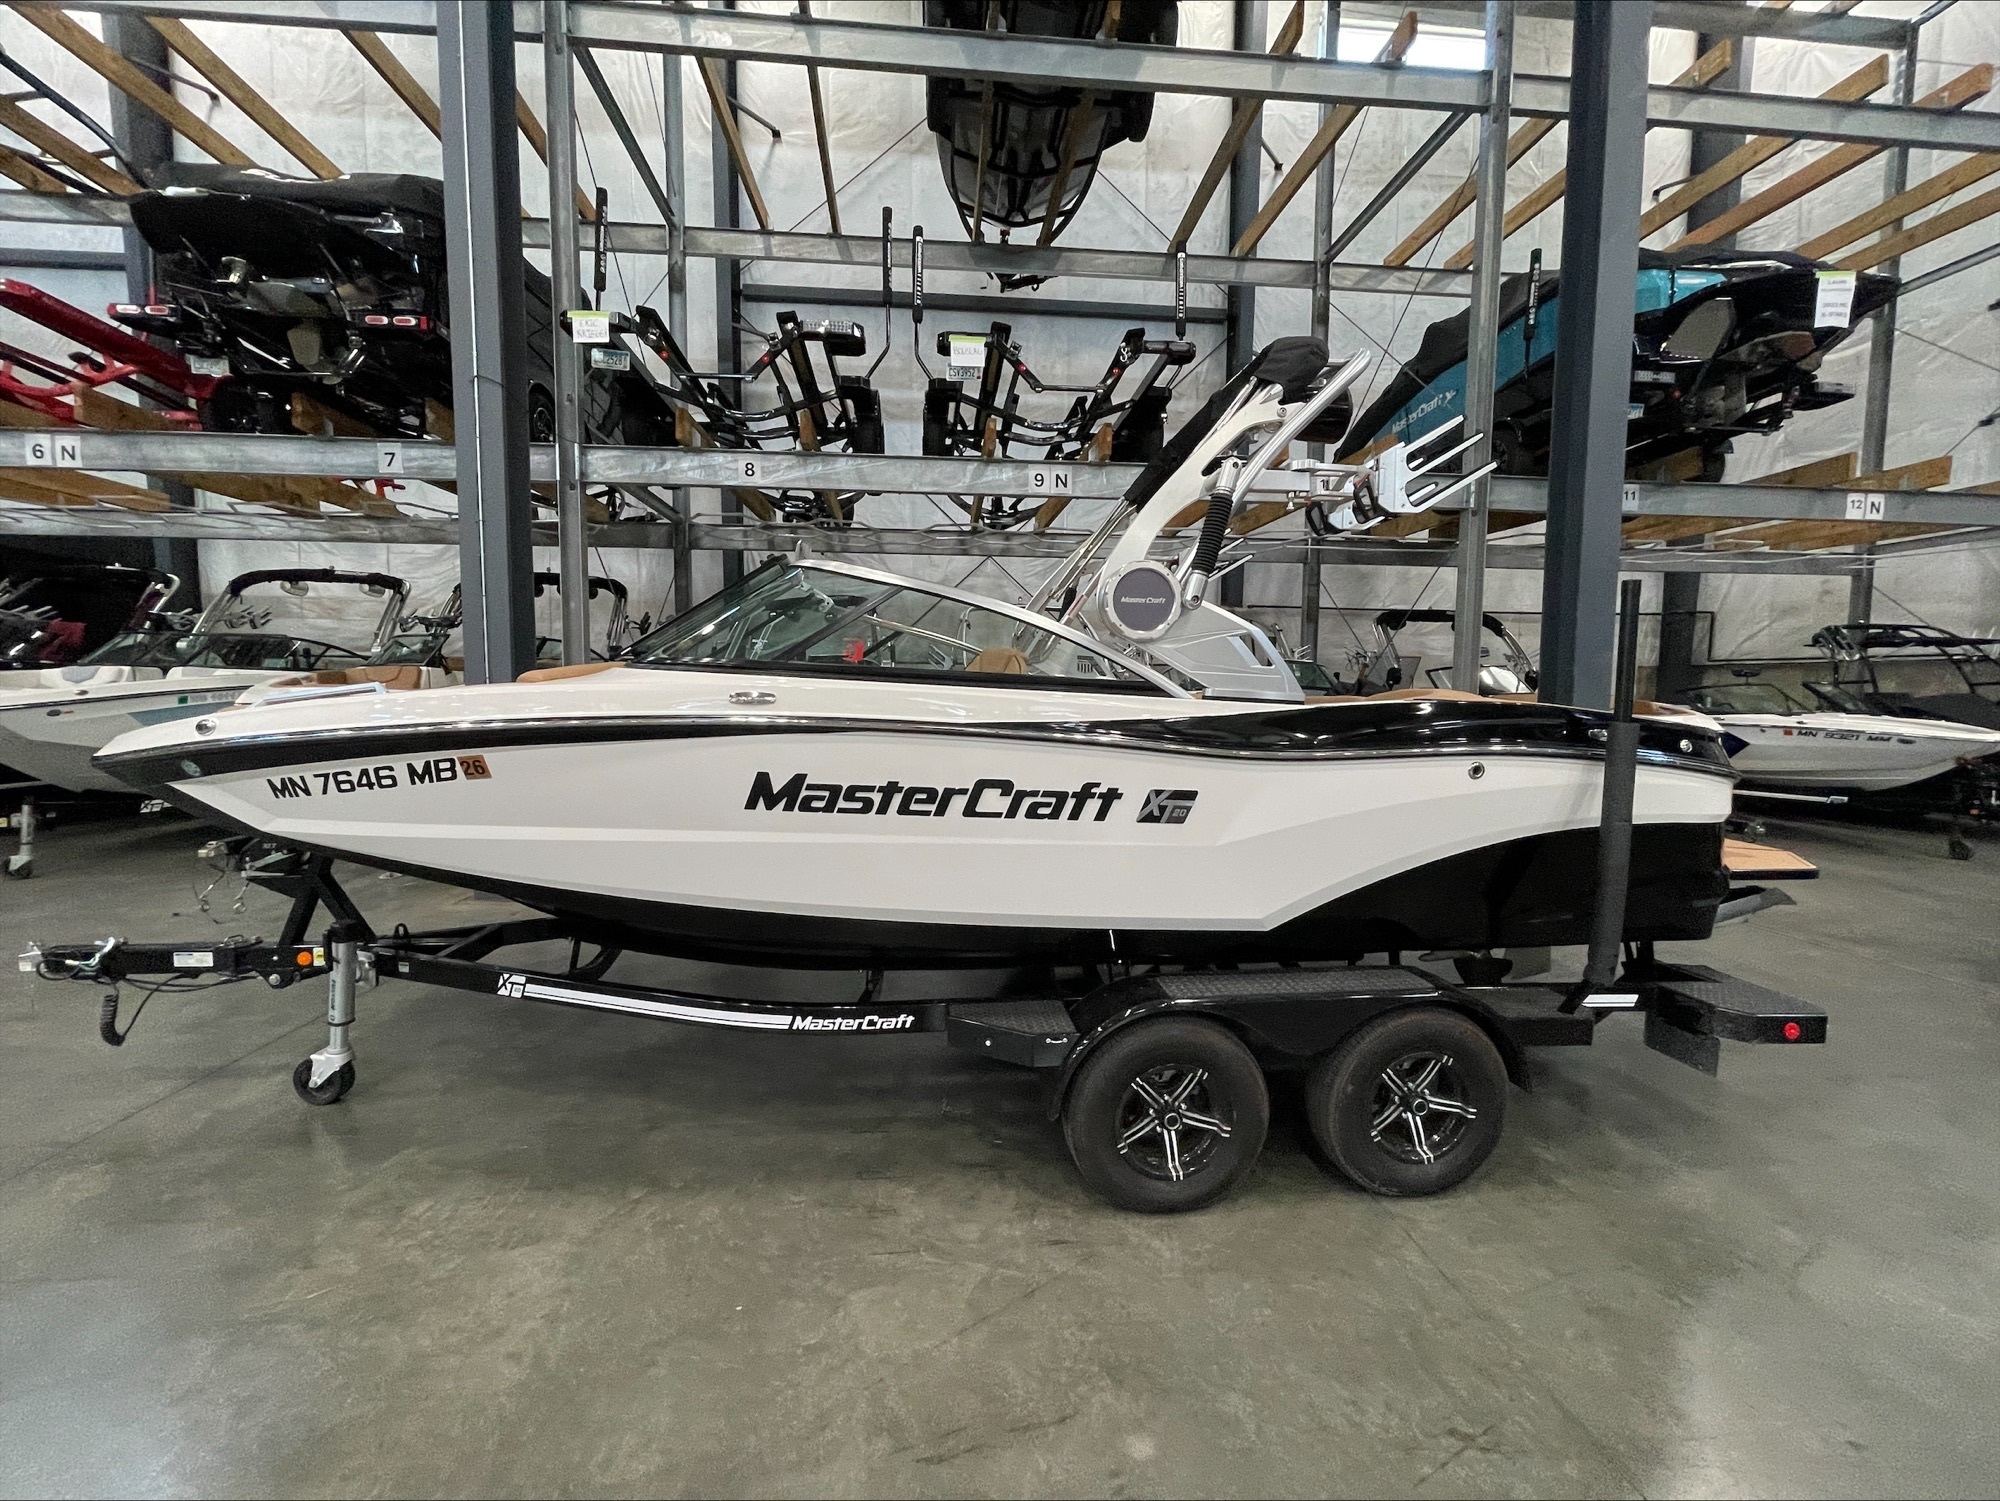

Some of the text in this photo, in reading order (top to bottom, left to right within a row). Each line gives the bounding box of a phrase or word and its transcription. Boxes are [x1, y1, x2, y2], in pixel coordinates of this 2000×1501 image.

[32, 443, 76, 461] 6 N
[384, 452, 396, 467] 7
[745, 462, 755, 477] 8
[1034, 473, 1068, 488] 9 N
[1623, 491, 1636, 500] 11
[1850, 500, 1881, 514] 12 N
[1121, 596, 1166, 604] MasterCraft
[460, 759, 486, 776] 26
[266, 757, 458, 799] MN 7646 MB
[744, 771, 1124, 822] MasterCraft
[792, 1014, 915, 1030] MasterCraft
